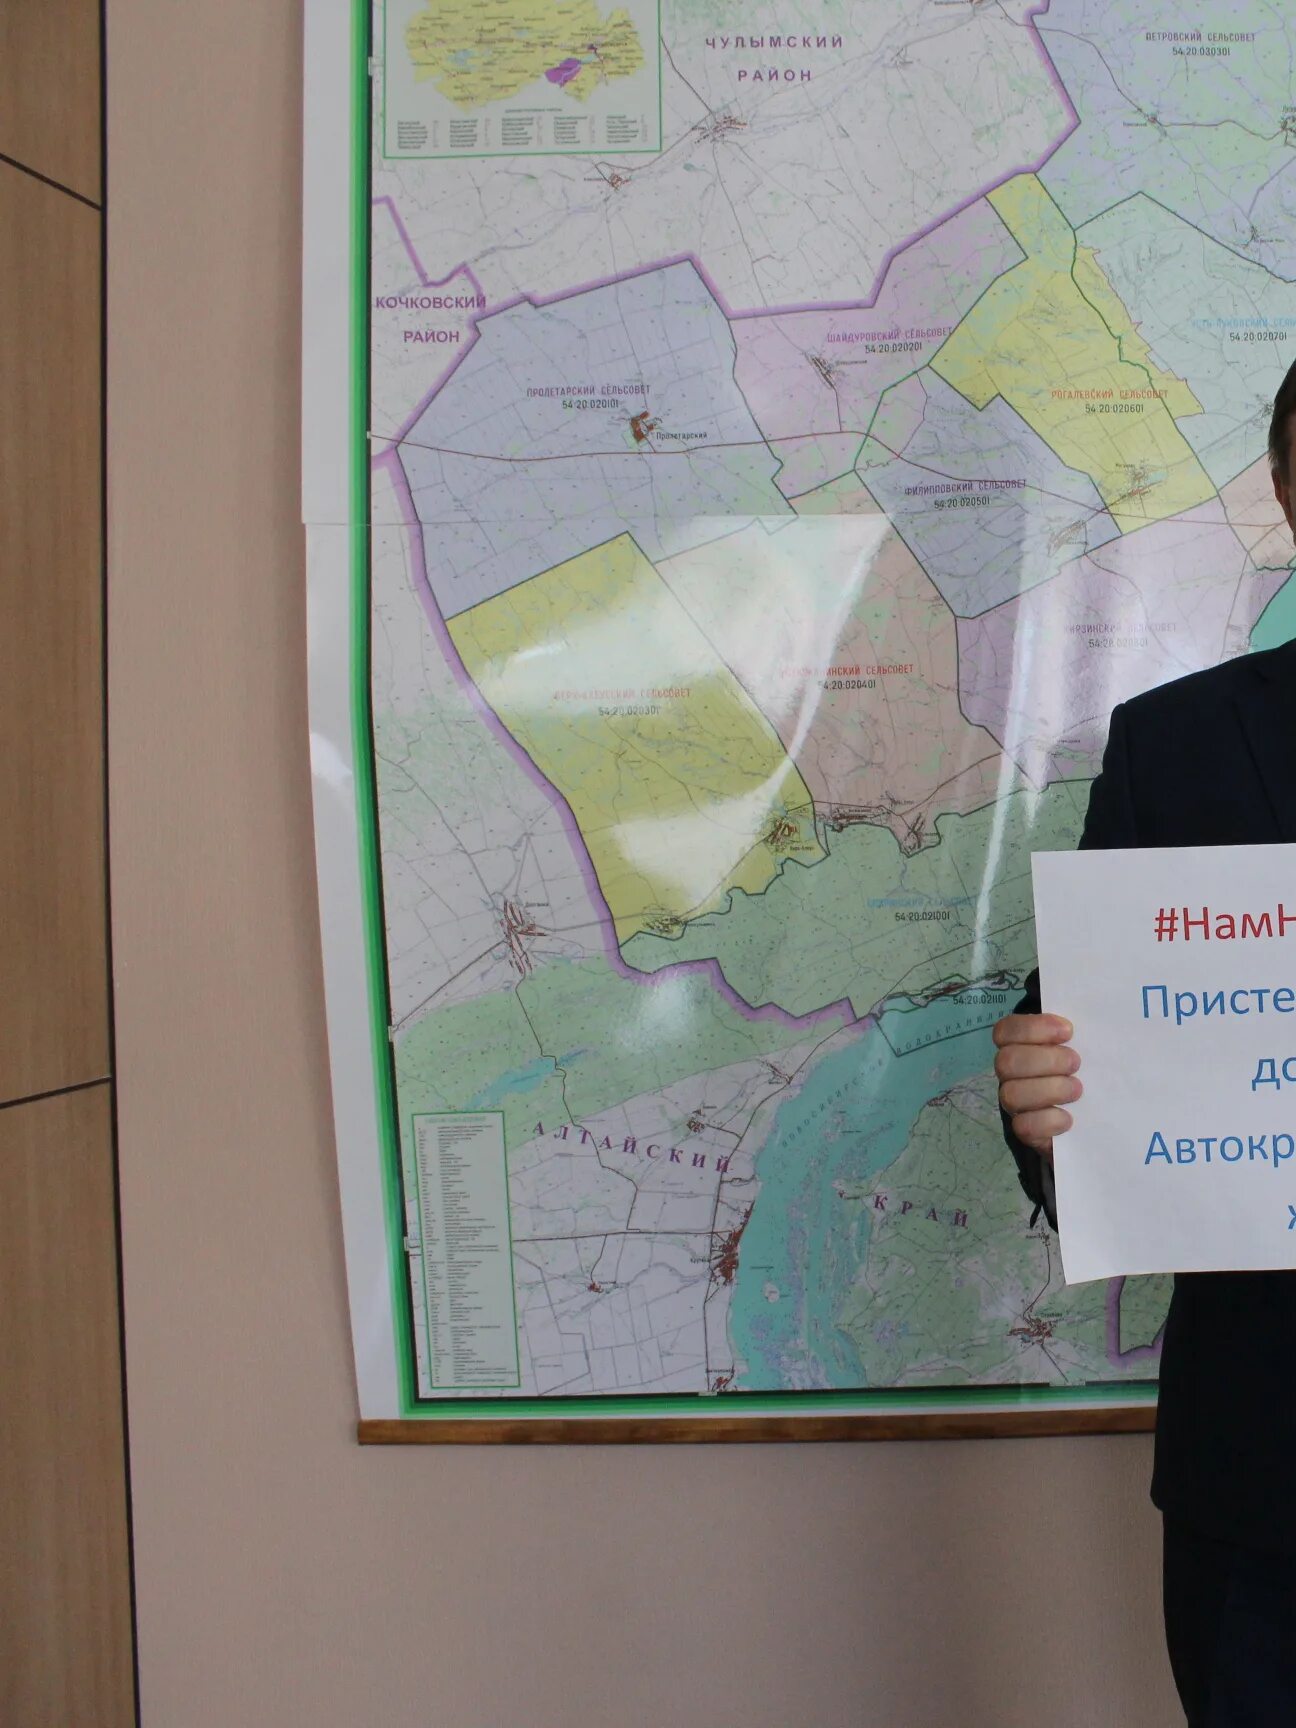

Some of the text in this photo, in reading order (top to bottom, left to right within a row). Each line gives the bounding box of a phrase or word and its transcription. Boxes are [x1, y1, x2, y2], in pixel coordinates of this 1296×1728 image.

[706, 34, 843, 49] ЧУЛЫМСКИЙ
[1146, 31, 1256, 42] ПЕТРОВСКИЙ СЕЛЬСОВЕТ
[738, 68, 811, 82] РАЙОН
[376, 294, 487, 309] КОЧКОВСКИЙ
[404, 328, 460, 343] РАЙОН
[827, 326, 953, 344] ШАЙДУРОВСКИЙ СЕЛЬСОВЕТ
[527, 383, 650, 398] ПРОЛЕТАРСКИЙ СЕЛЬСОВЕТ
[1052, 388, 1169, 400] РОГАЛЕВСКИЙ СЕЛЬСОВЕТ
[905, 479, 1026, 497] ФИЛИППОВСКИЙ СЕЛЬСОВЕТ
[866, 664, 914, 676] СЕЛЬСОВЕТ
[533, 1121, 730, 1173] АЛТАЙСКИЙ
[874, 1194, 969, 1228] КРАЙ
